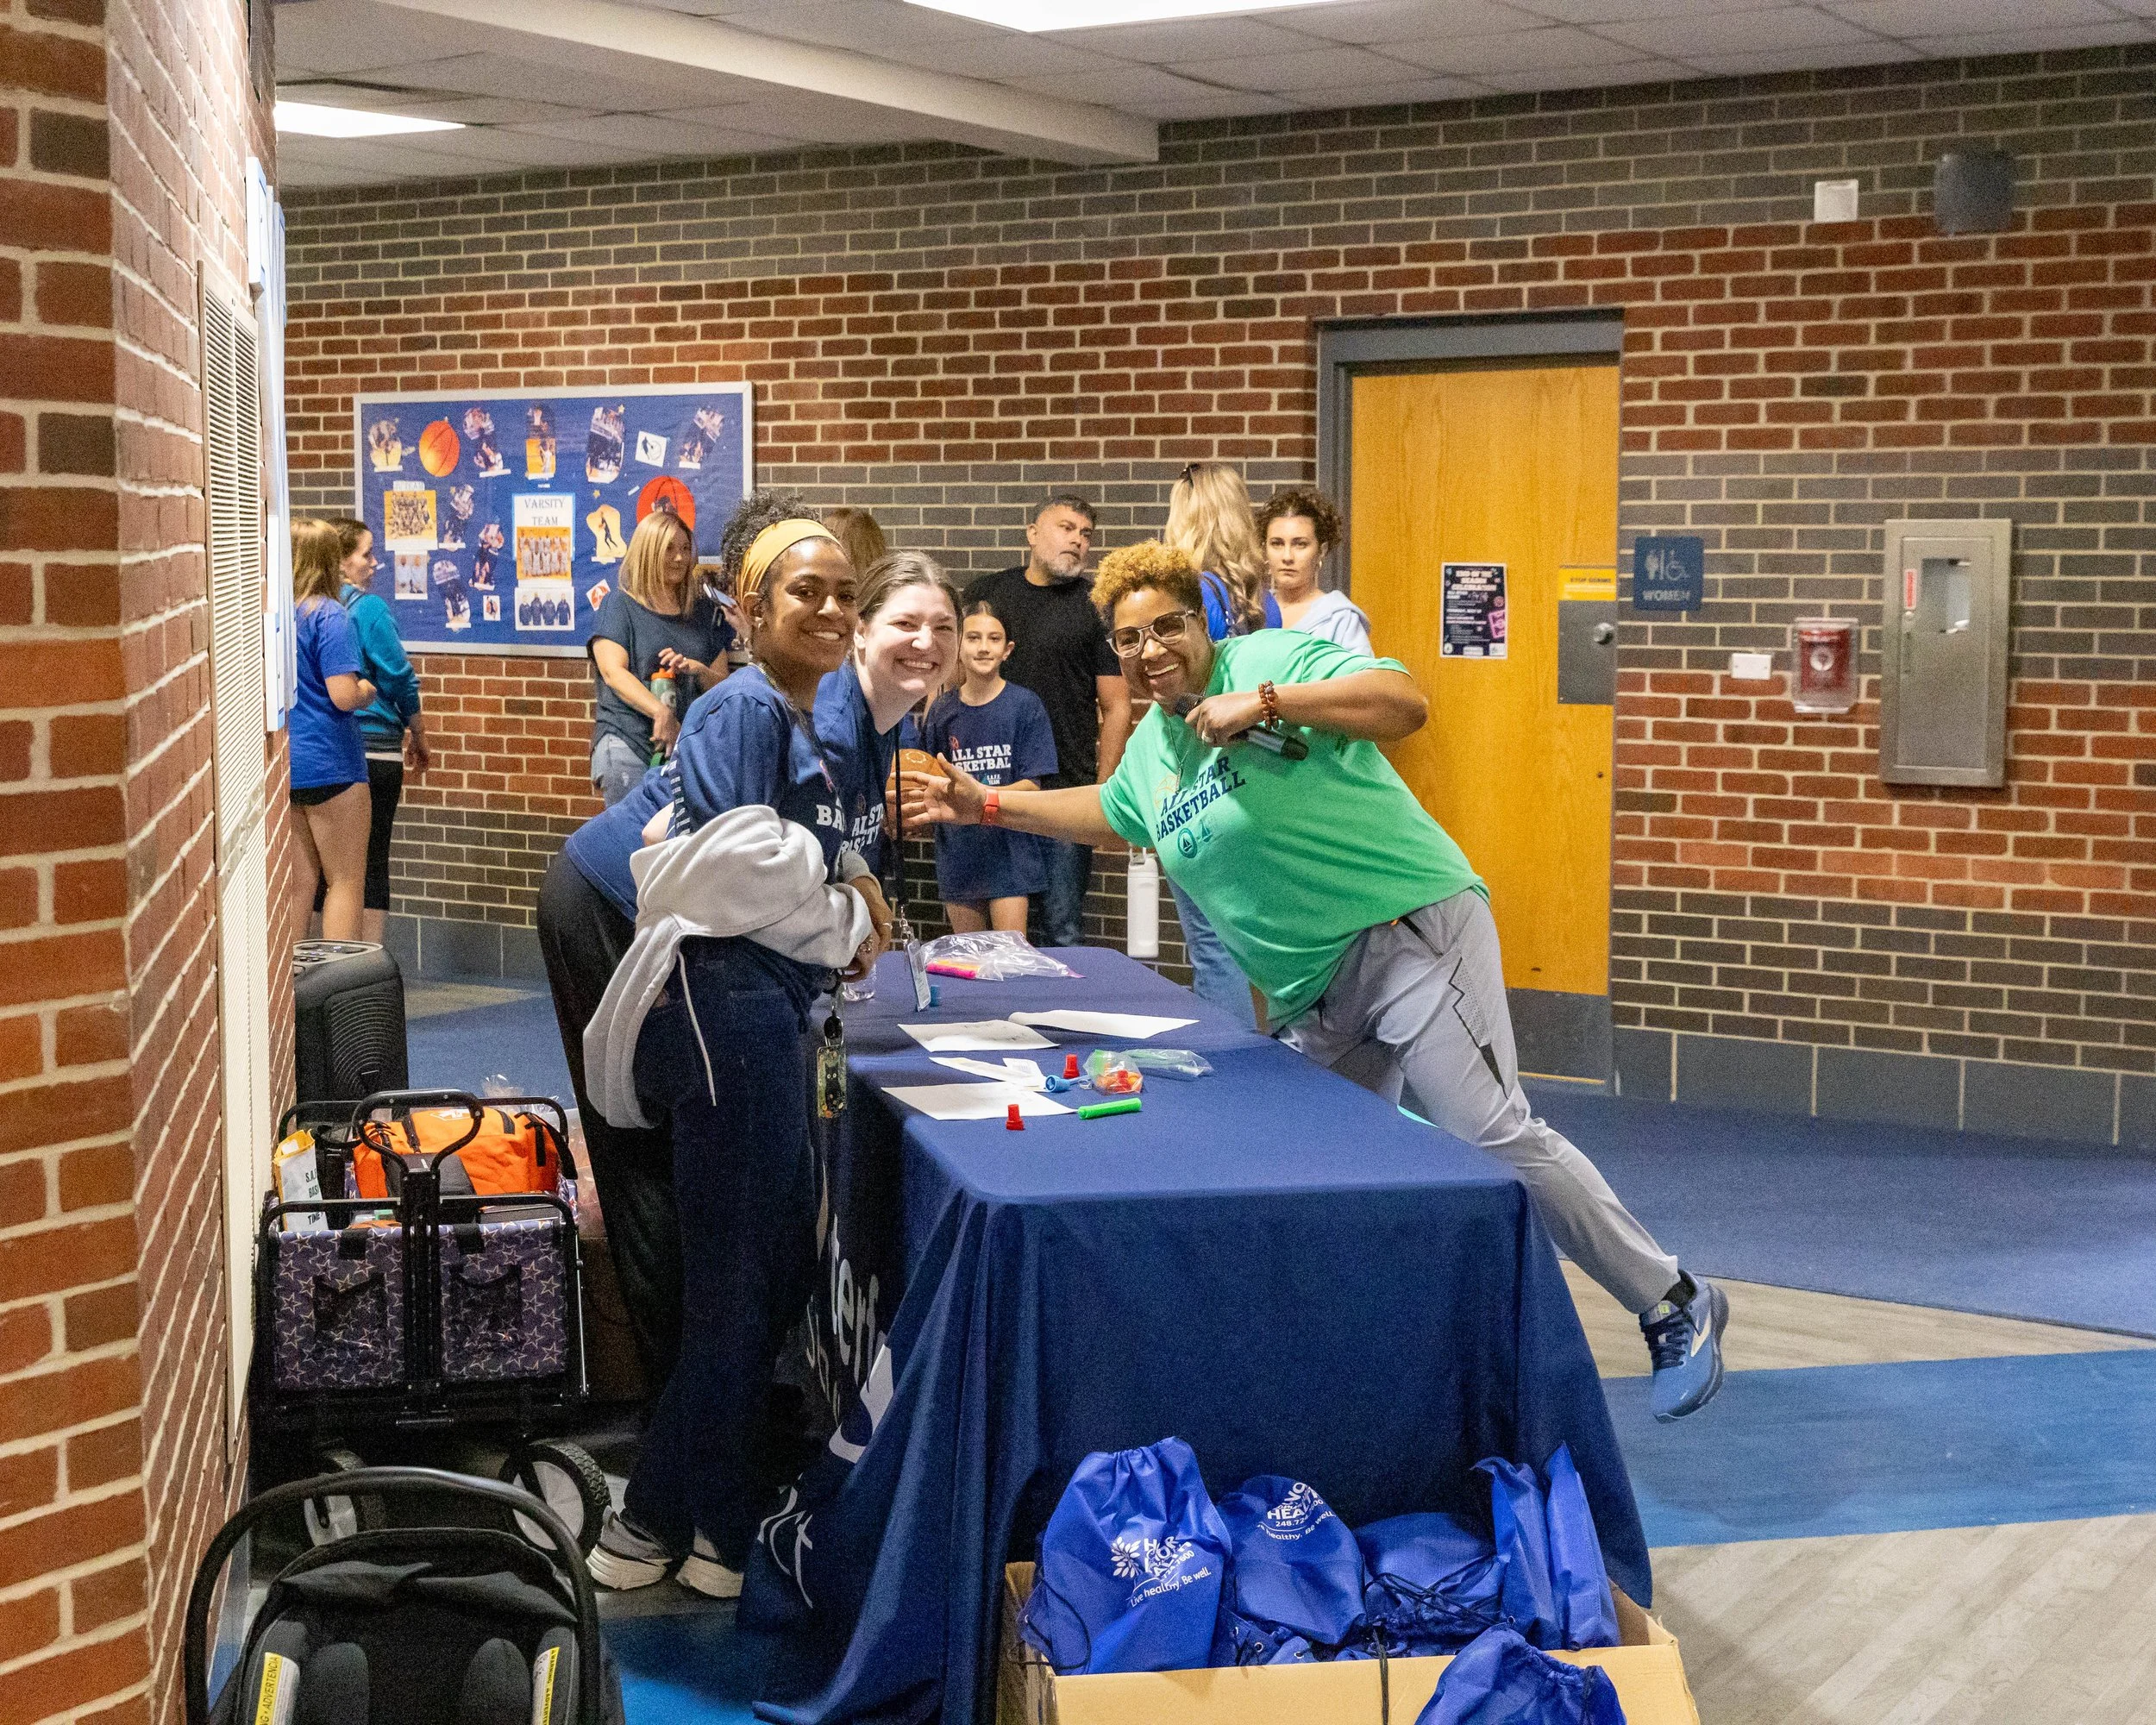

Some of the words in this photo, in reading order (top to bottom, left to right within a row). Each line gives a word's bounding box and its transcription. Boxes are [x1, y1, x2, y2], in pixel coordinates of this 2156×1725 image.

[524, 498, 565, 509] VARSITY
[531, 517, 558, 526] TEAM
[1642, 590, 1690, 601] WOMEN
[952, 748, 975, 762] ALL
[976, 744, 1012, 759] STAR
[1156, 770, 1247, 842] BASKETBALL
[1305, 1524, 1315, 1534] Be
[1131, 1593, 1144, 1607] Live
[1181, 1575, 1193, 1585] Be
[263, 1656, 279, 1709] ADVERTENCIA
